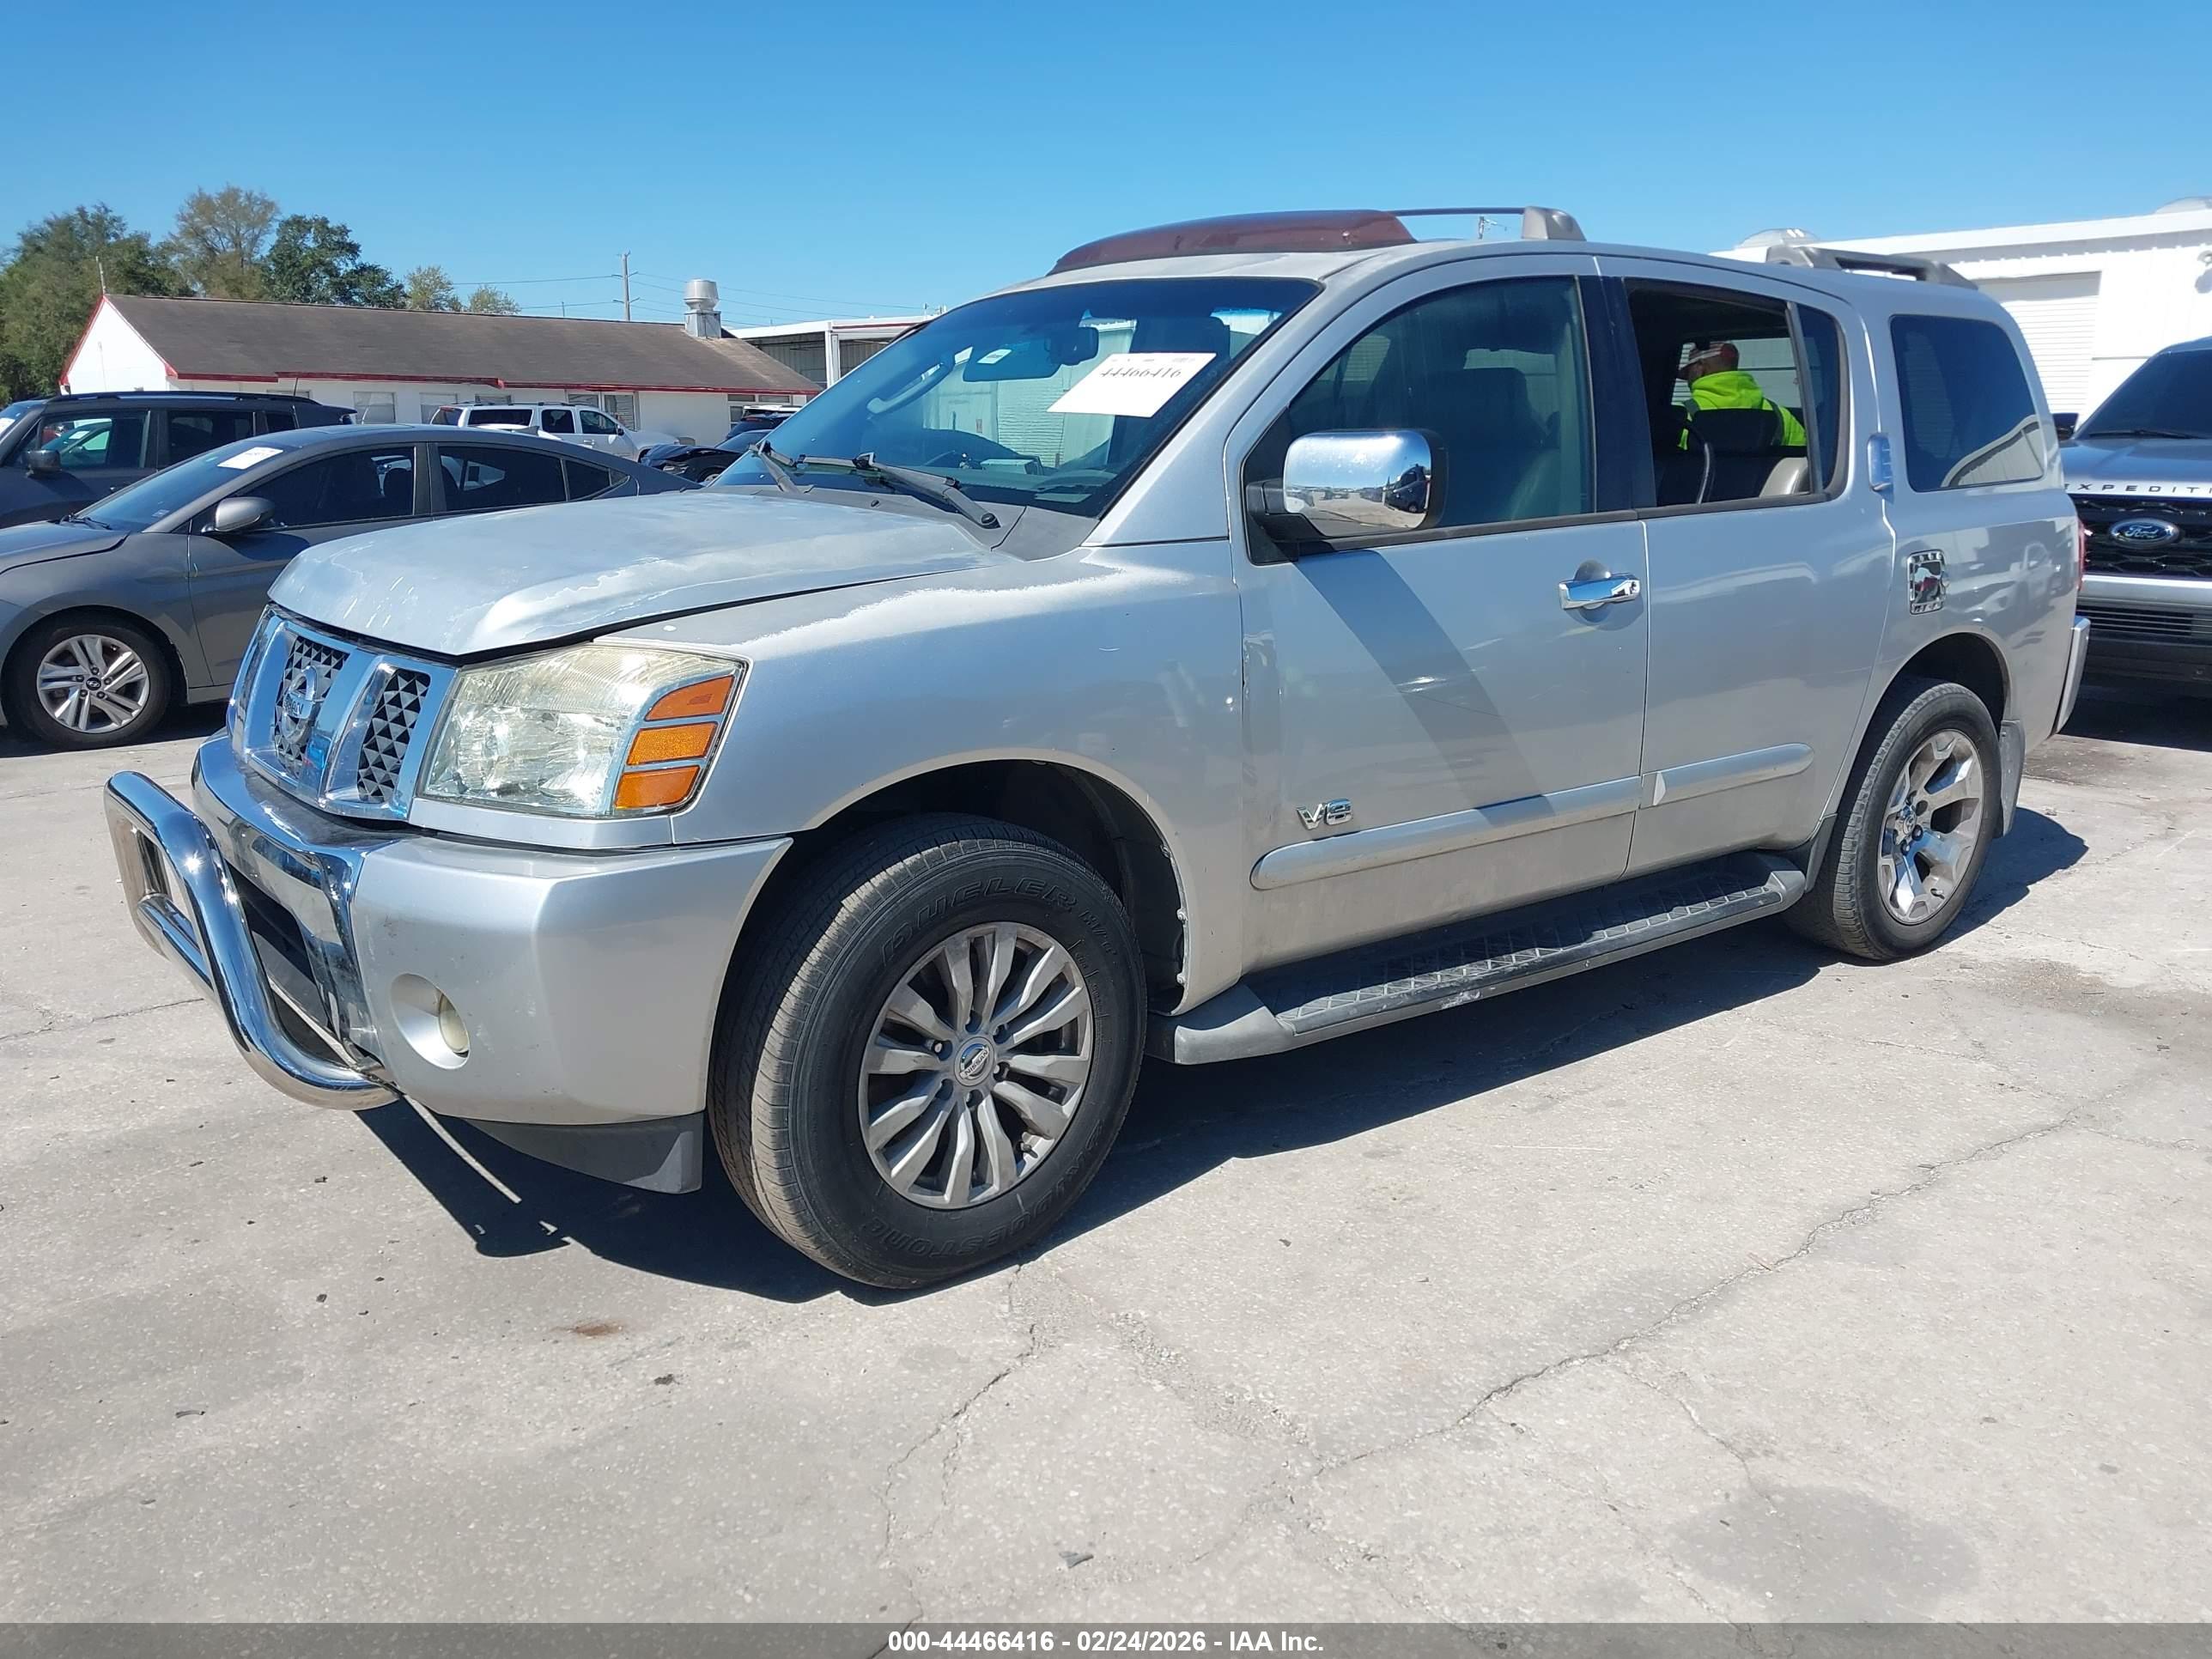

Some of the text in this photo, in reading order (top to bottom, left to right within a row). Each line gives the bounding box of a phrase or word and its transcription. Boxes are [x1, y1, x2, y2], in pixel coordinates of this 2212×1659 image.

[2125, 525, 2158, 539] Ford
[1296, 798, 1353, 830] V8
[963, 1049, 988, 1076] NISSAN
